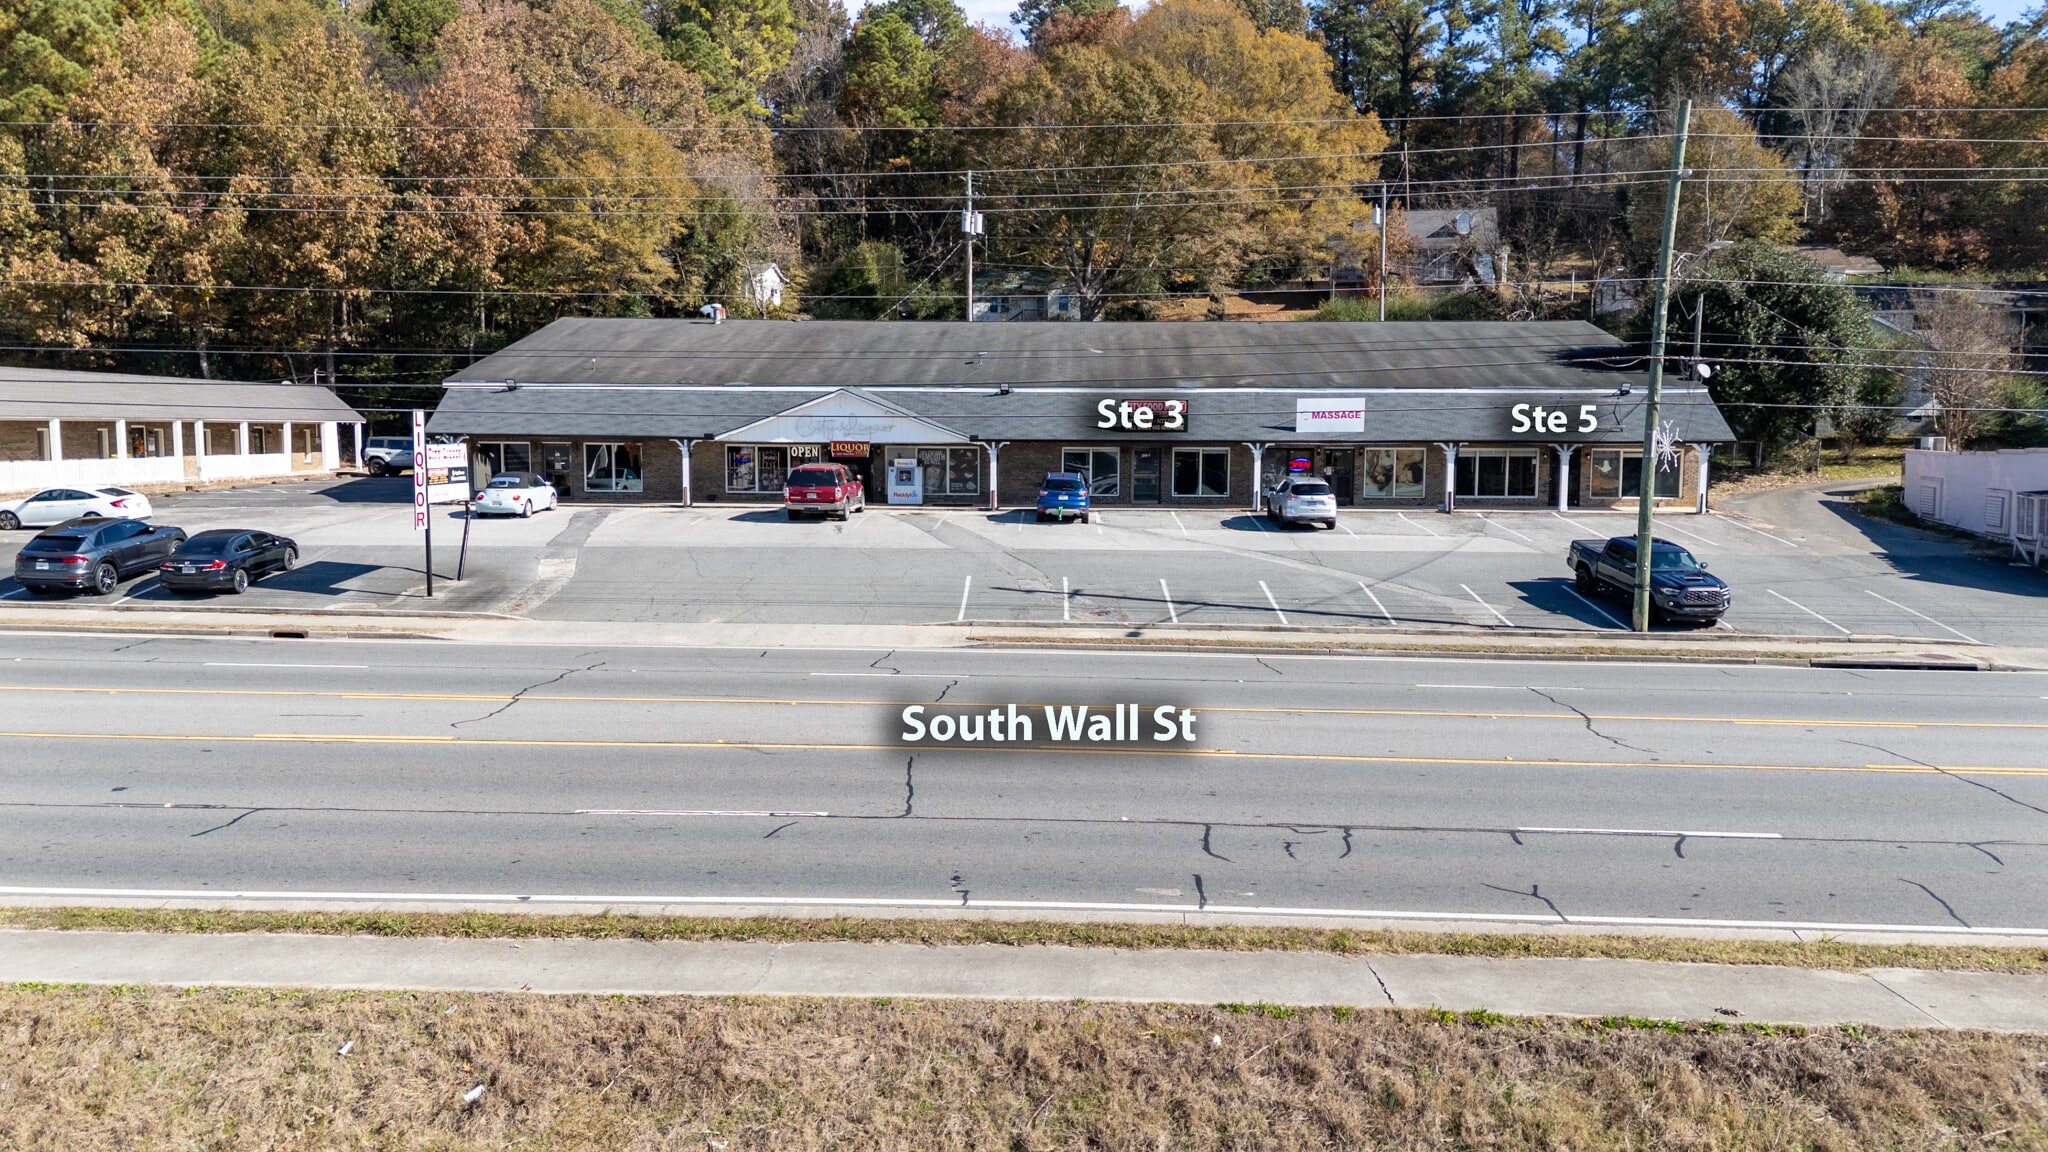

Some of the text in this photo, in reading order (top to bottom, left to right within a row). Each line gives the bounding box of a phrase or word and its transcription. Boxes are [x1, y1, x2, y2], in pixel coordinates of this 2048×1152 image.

[1311, 410, 1361, 419] MASSAGE
[791, 447, 818, 457] OPEN
[831, 442, 869, 452] LIQUOR
[415, 411, 425, 527] LIQUOR
[1289, 460, 1311, 469] OPEN
